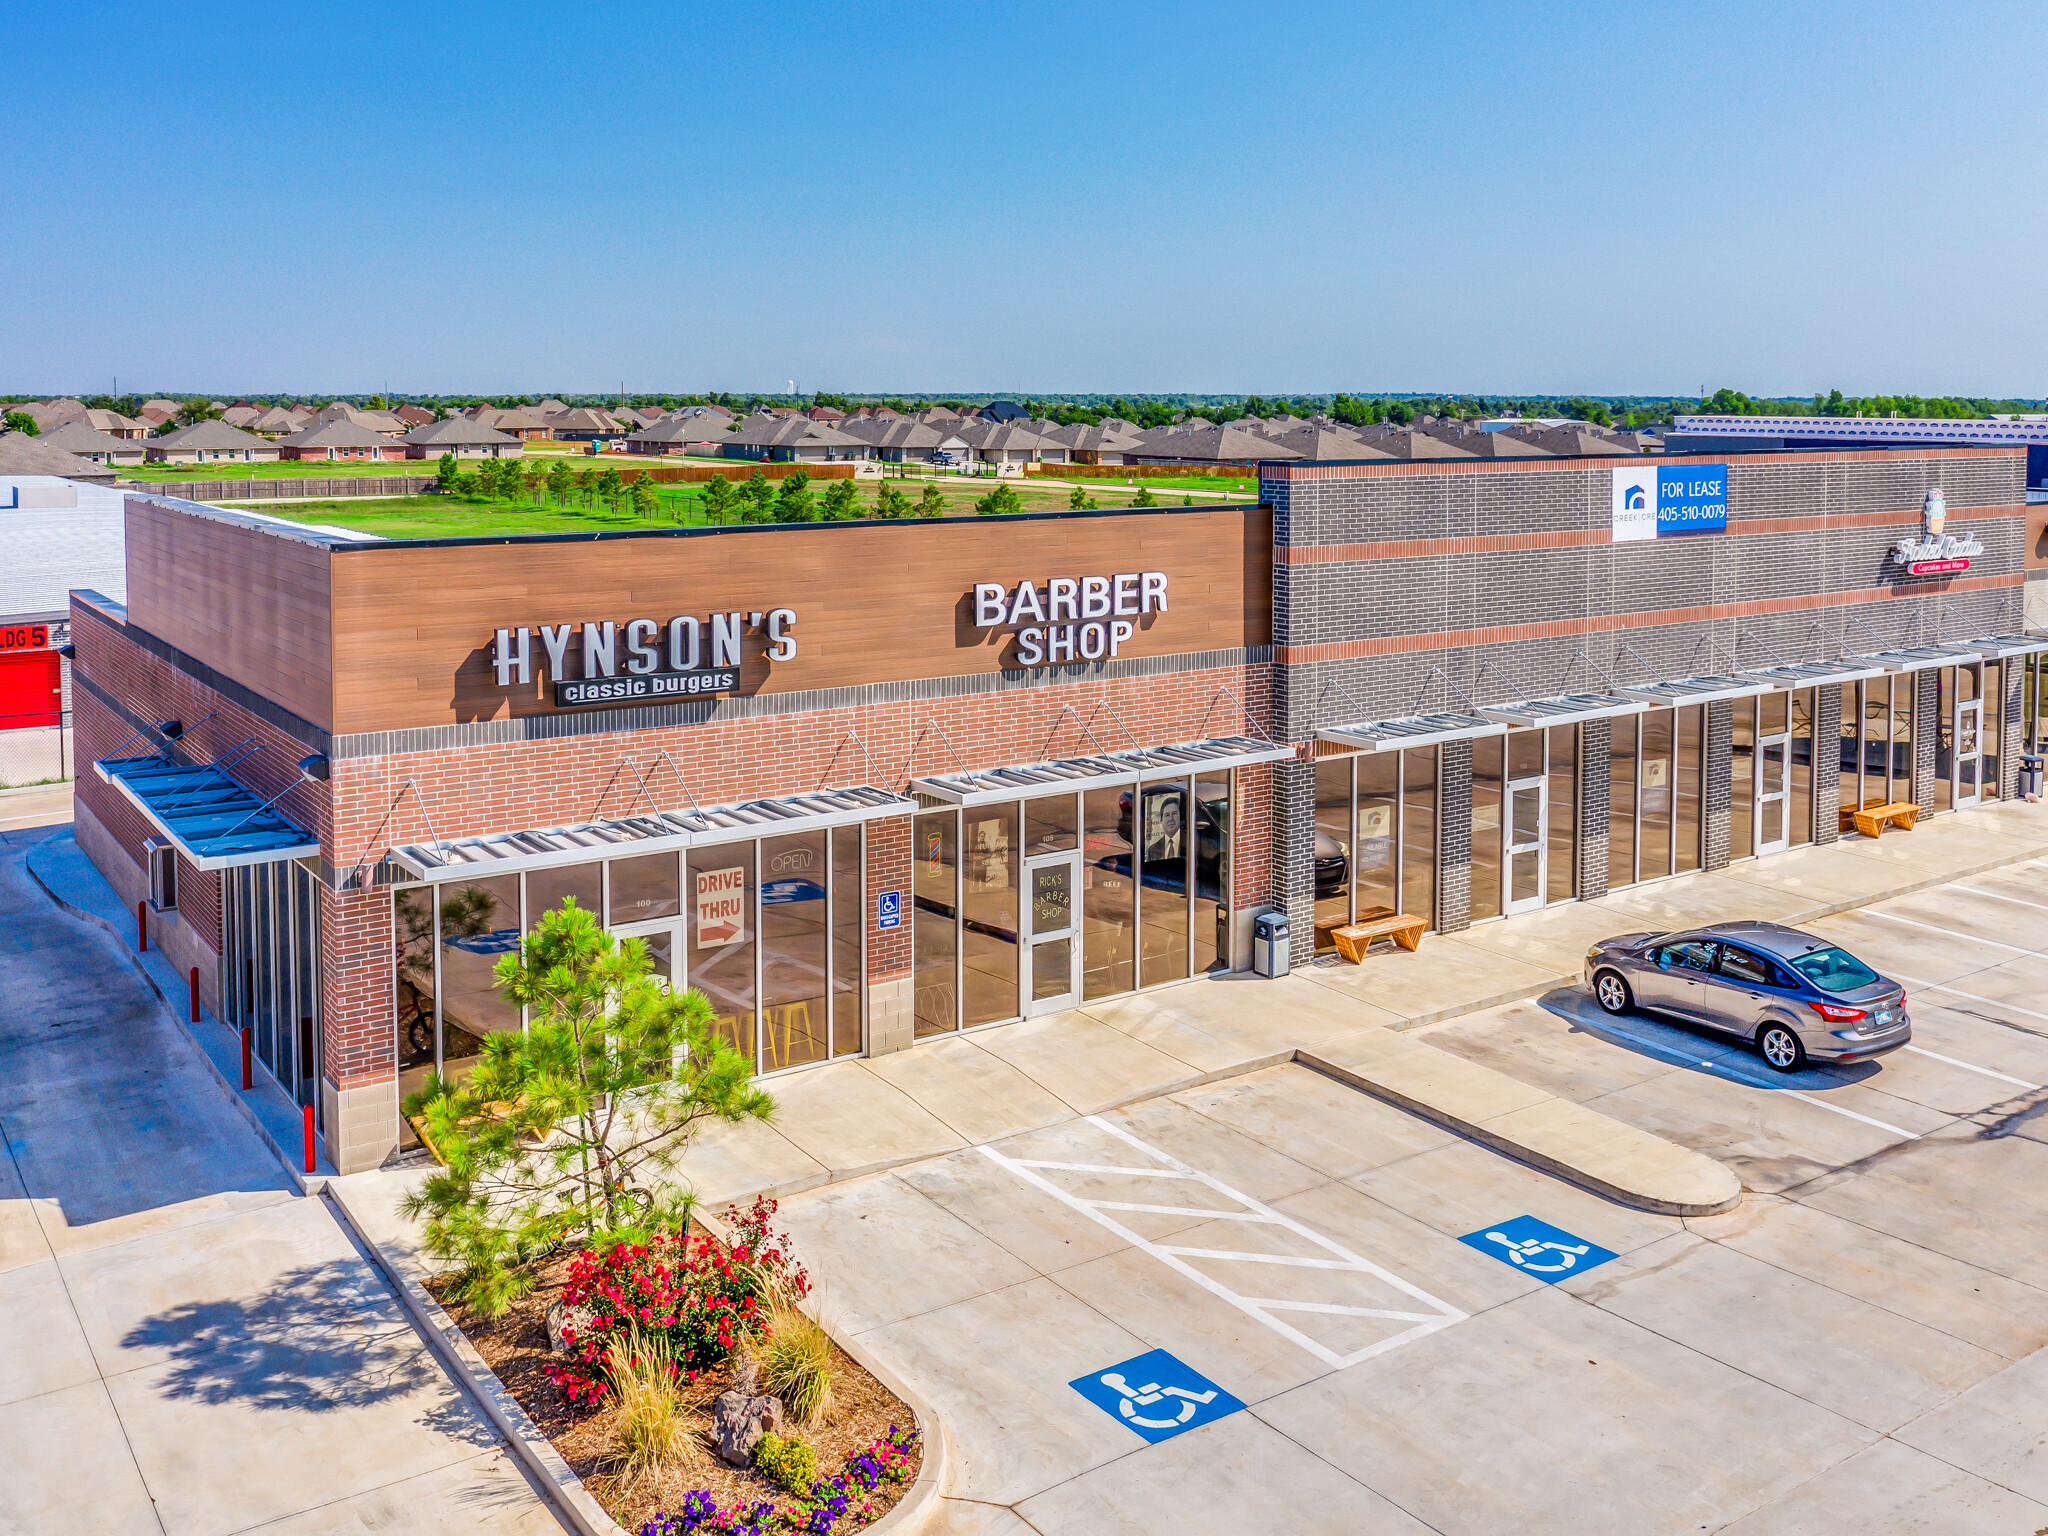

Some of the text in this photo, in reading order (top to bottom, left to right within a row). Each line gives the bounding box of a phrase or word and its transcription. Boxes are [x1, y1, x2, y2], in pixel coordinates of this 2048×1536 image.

[1661, 480, 1722, 499] FOR LEASE
[1657, 504, 1726, 522] 405-510-0079
[1918, 560, 1965, 573] Cupcakes and More
[973, 571, 1169, 628] BARBER
[31, 627, 46, 648] 5
[492, 608, 798, 687] HYNSON'S
[1016, 620, 1134, 666] SHOP
[564, 671, 734, 701] classic burgers
[1042, 834, 1054, 843] 105
[1083, 836, 1112, 852] OPEN
[771, 851, 811, 872] OPEN
[697, 870, 743, 895] DRIVE
[1039, 873, 1062, 888] RICK'S
[635, 898, 651, 908] 100
[699, 897, 741, 921] THRU
[1033, 890, 1070, 912] BARBER
[1041, 907, 1062, 920] SHOP
